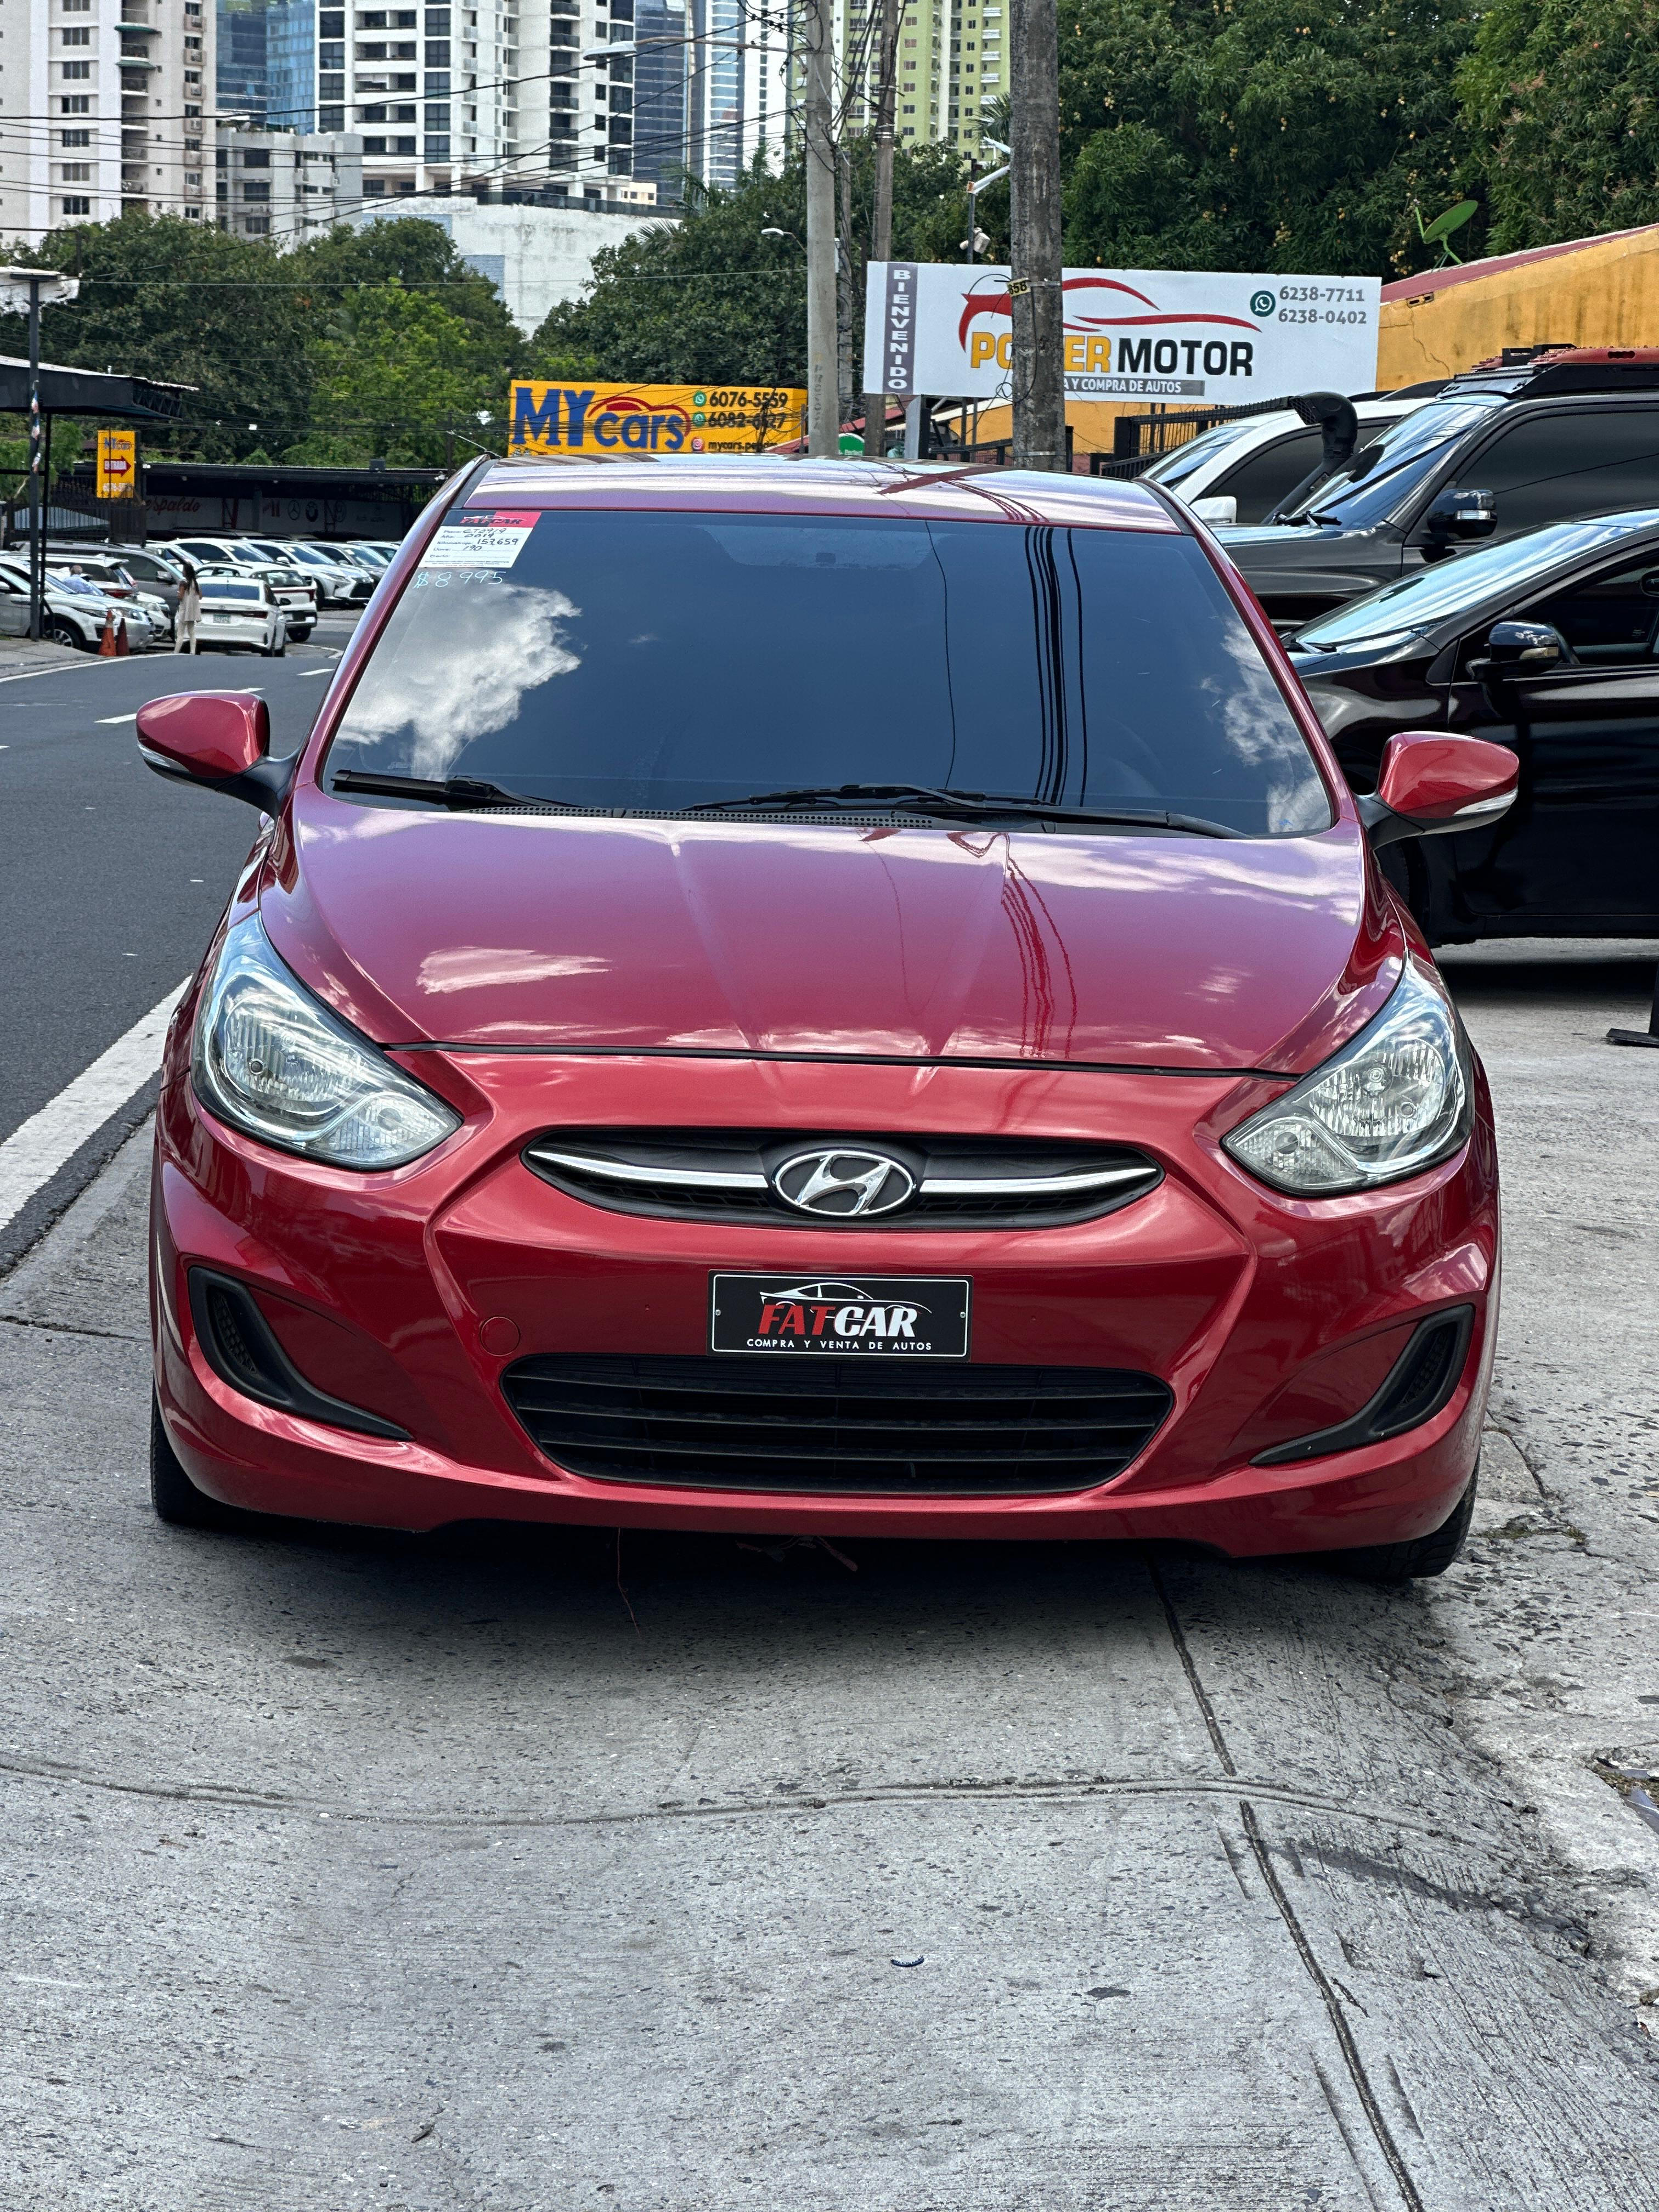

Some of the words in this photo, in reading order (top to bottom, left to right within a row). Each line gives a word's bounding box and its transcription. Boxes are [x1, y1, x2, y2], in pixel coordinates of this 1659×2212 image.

[1279, 285, 1365, 302] 6238-7711
[1278, 308, 1367, 325] 6238-0402
[888, 269, 911, 390] BIENVENIDO
[970, 331, 1111, 373] POER
[1118, 337, 1254, 377] MOTOR
[1071, 378, 1080, 390] Y
[1081, 379, 1126, 392] COMPRA
[1129, 380, 1143, 392] DE
[1146, 381, 1182, 393] AUTOS
[511, 387, 595, 447] MY
[593, 411, 685, 450] cars
[758, 1304, 918, 1338] FATCAR
[747, 1338, 795, 1348] COMPRA
[804, 1340, 811, 1348] Y
[820, 1340, 860, 1350] VENTA
[868, 1341, 883, 1350] DE
[892, 1341, 932, 1351] AUTOS
